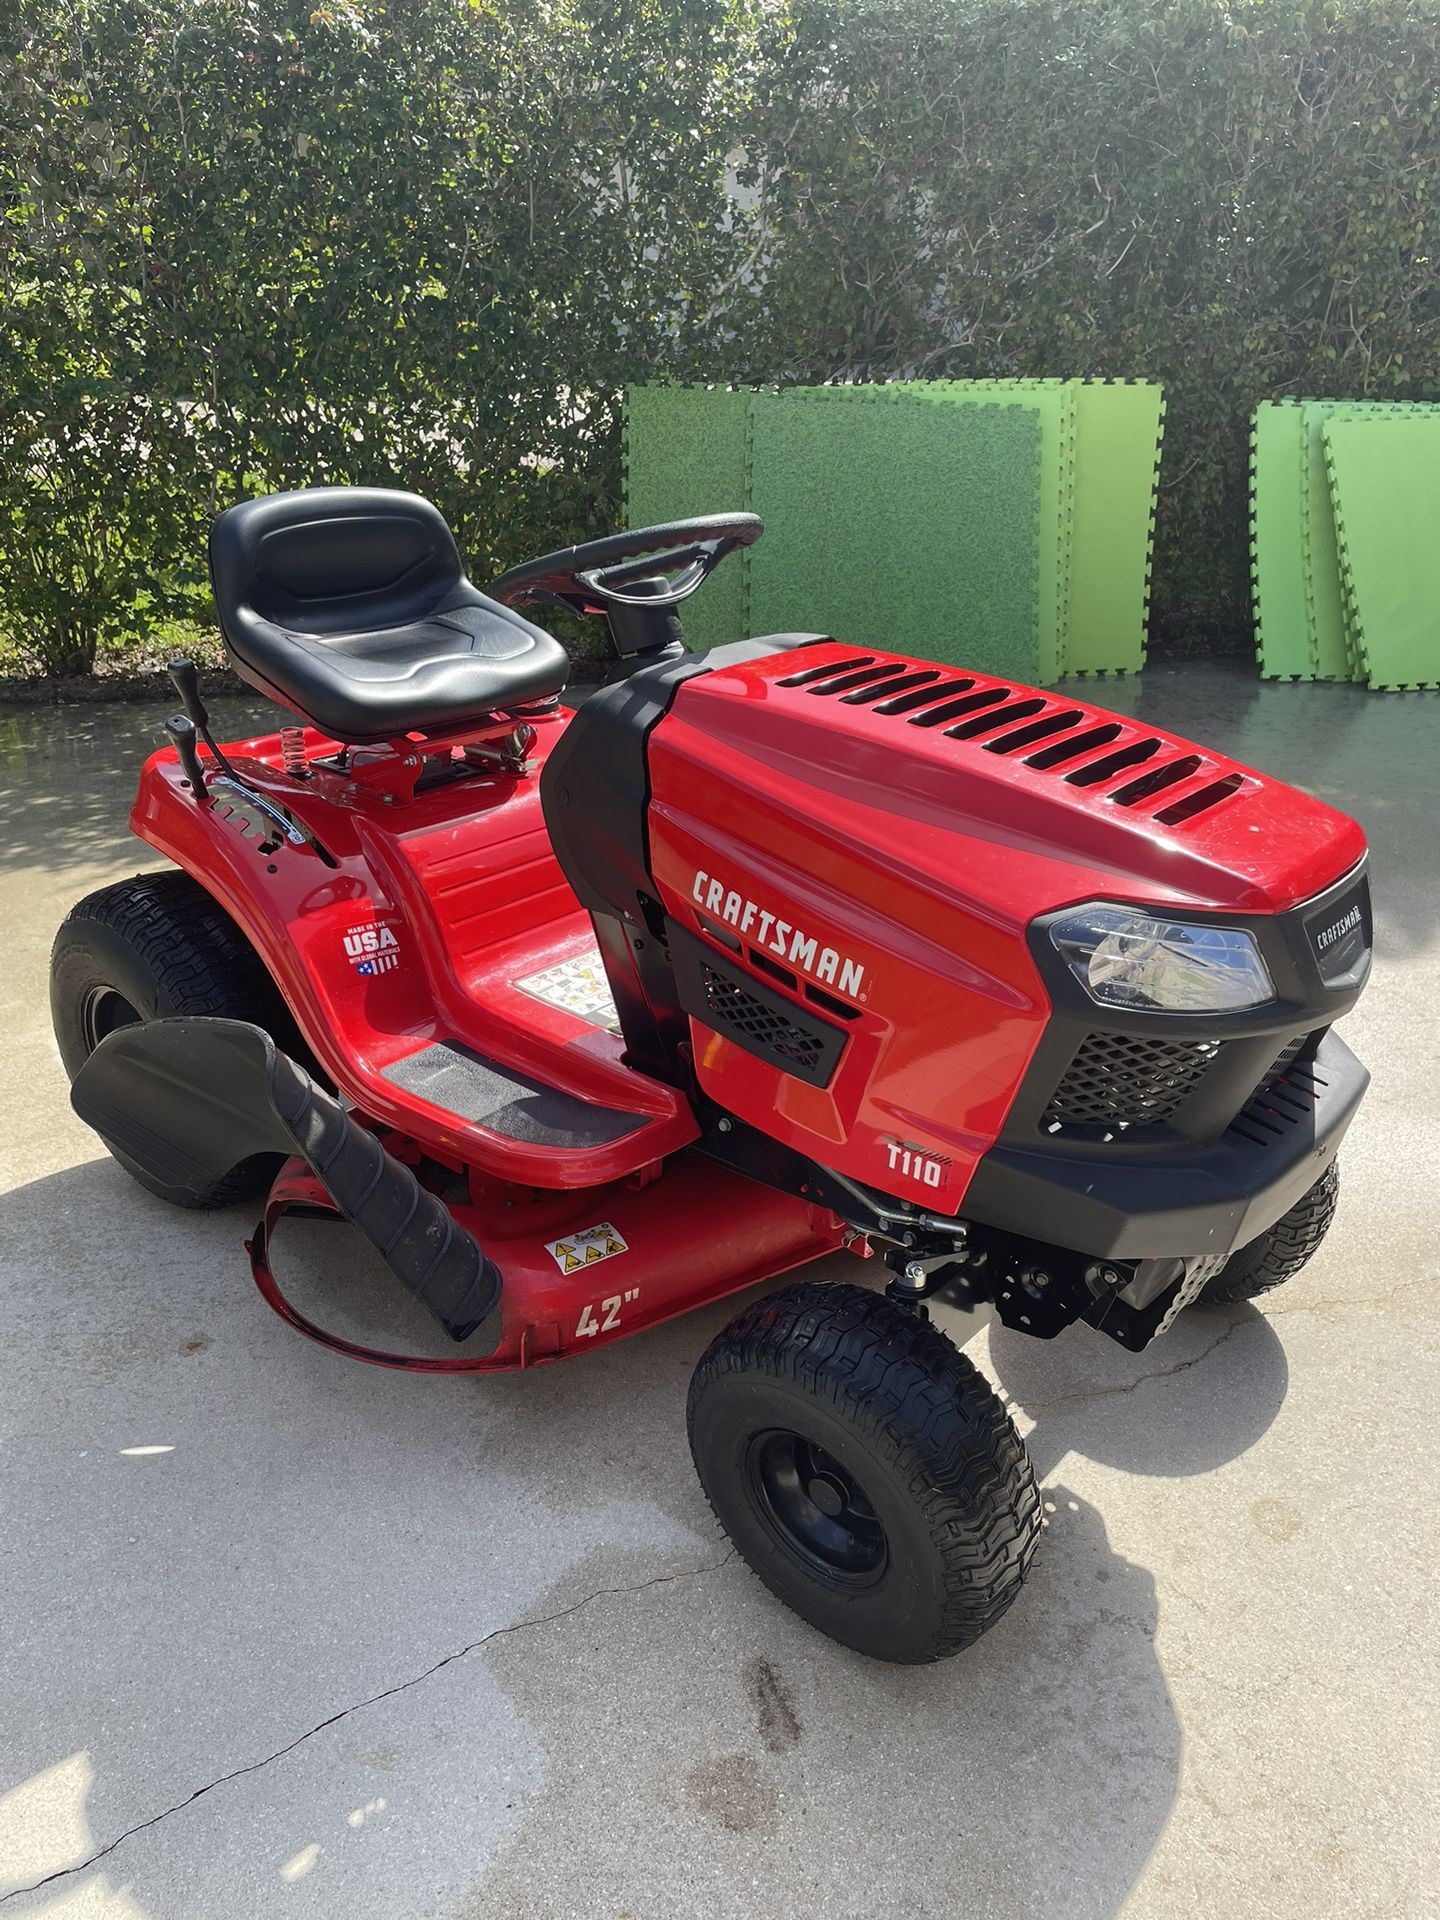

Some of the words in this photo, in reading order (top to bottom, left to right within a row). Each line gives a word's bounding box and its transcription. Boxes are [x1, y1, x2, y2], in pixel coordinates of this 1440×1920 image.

[343, 927, 398, 956] USA
[347, 926, 365, 935] MADE
[692, 870, 864, 998] CRAFTSMAN
[1317, 905, 1362, 950] CRAFTSMAN
[887, 1143, 941, 1188] T110
[575, 1287, 640, 1338] 42"
